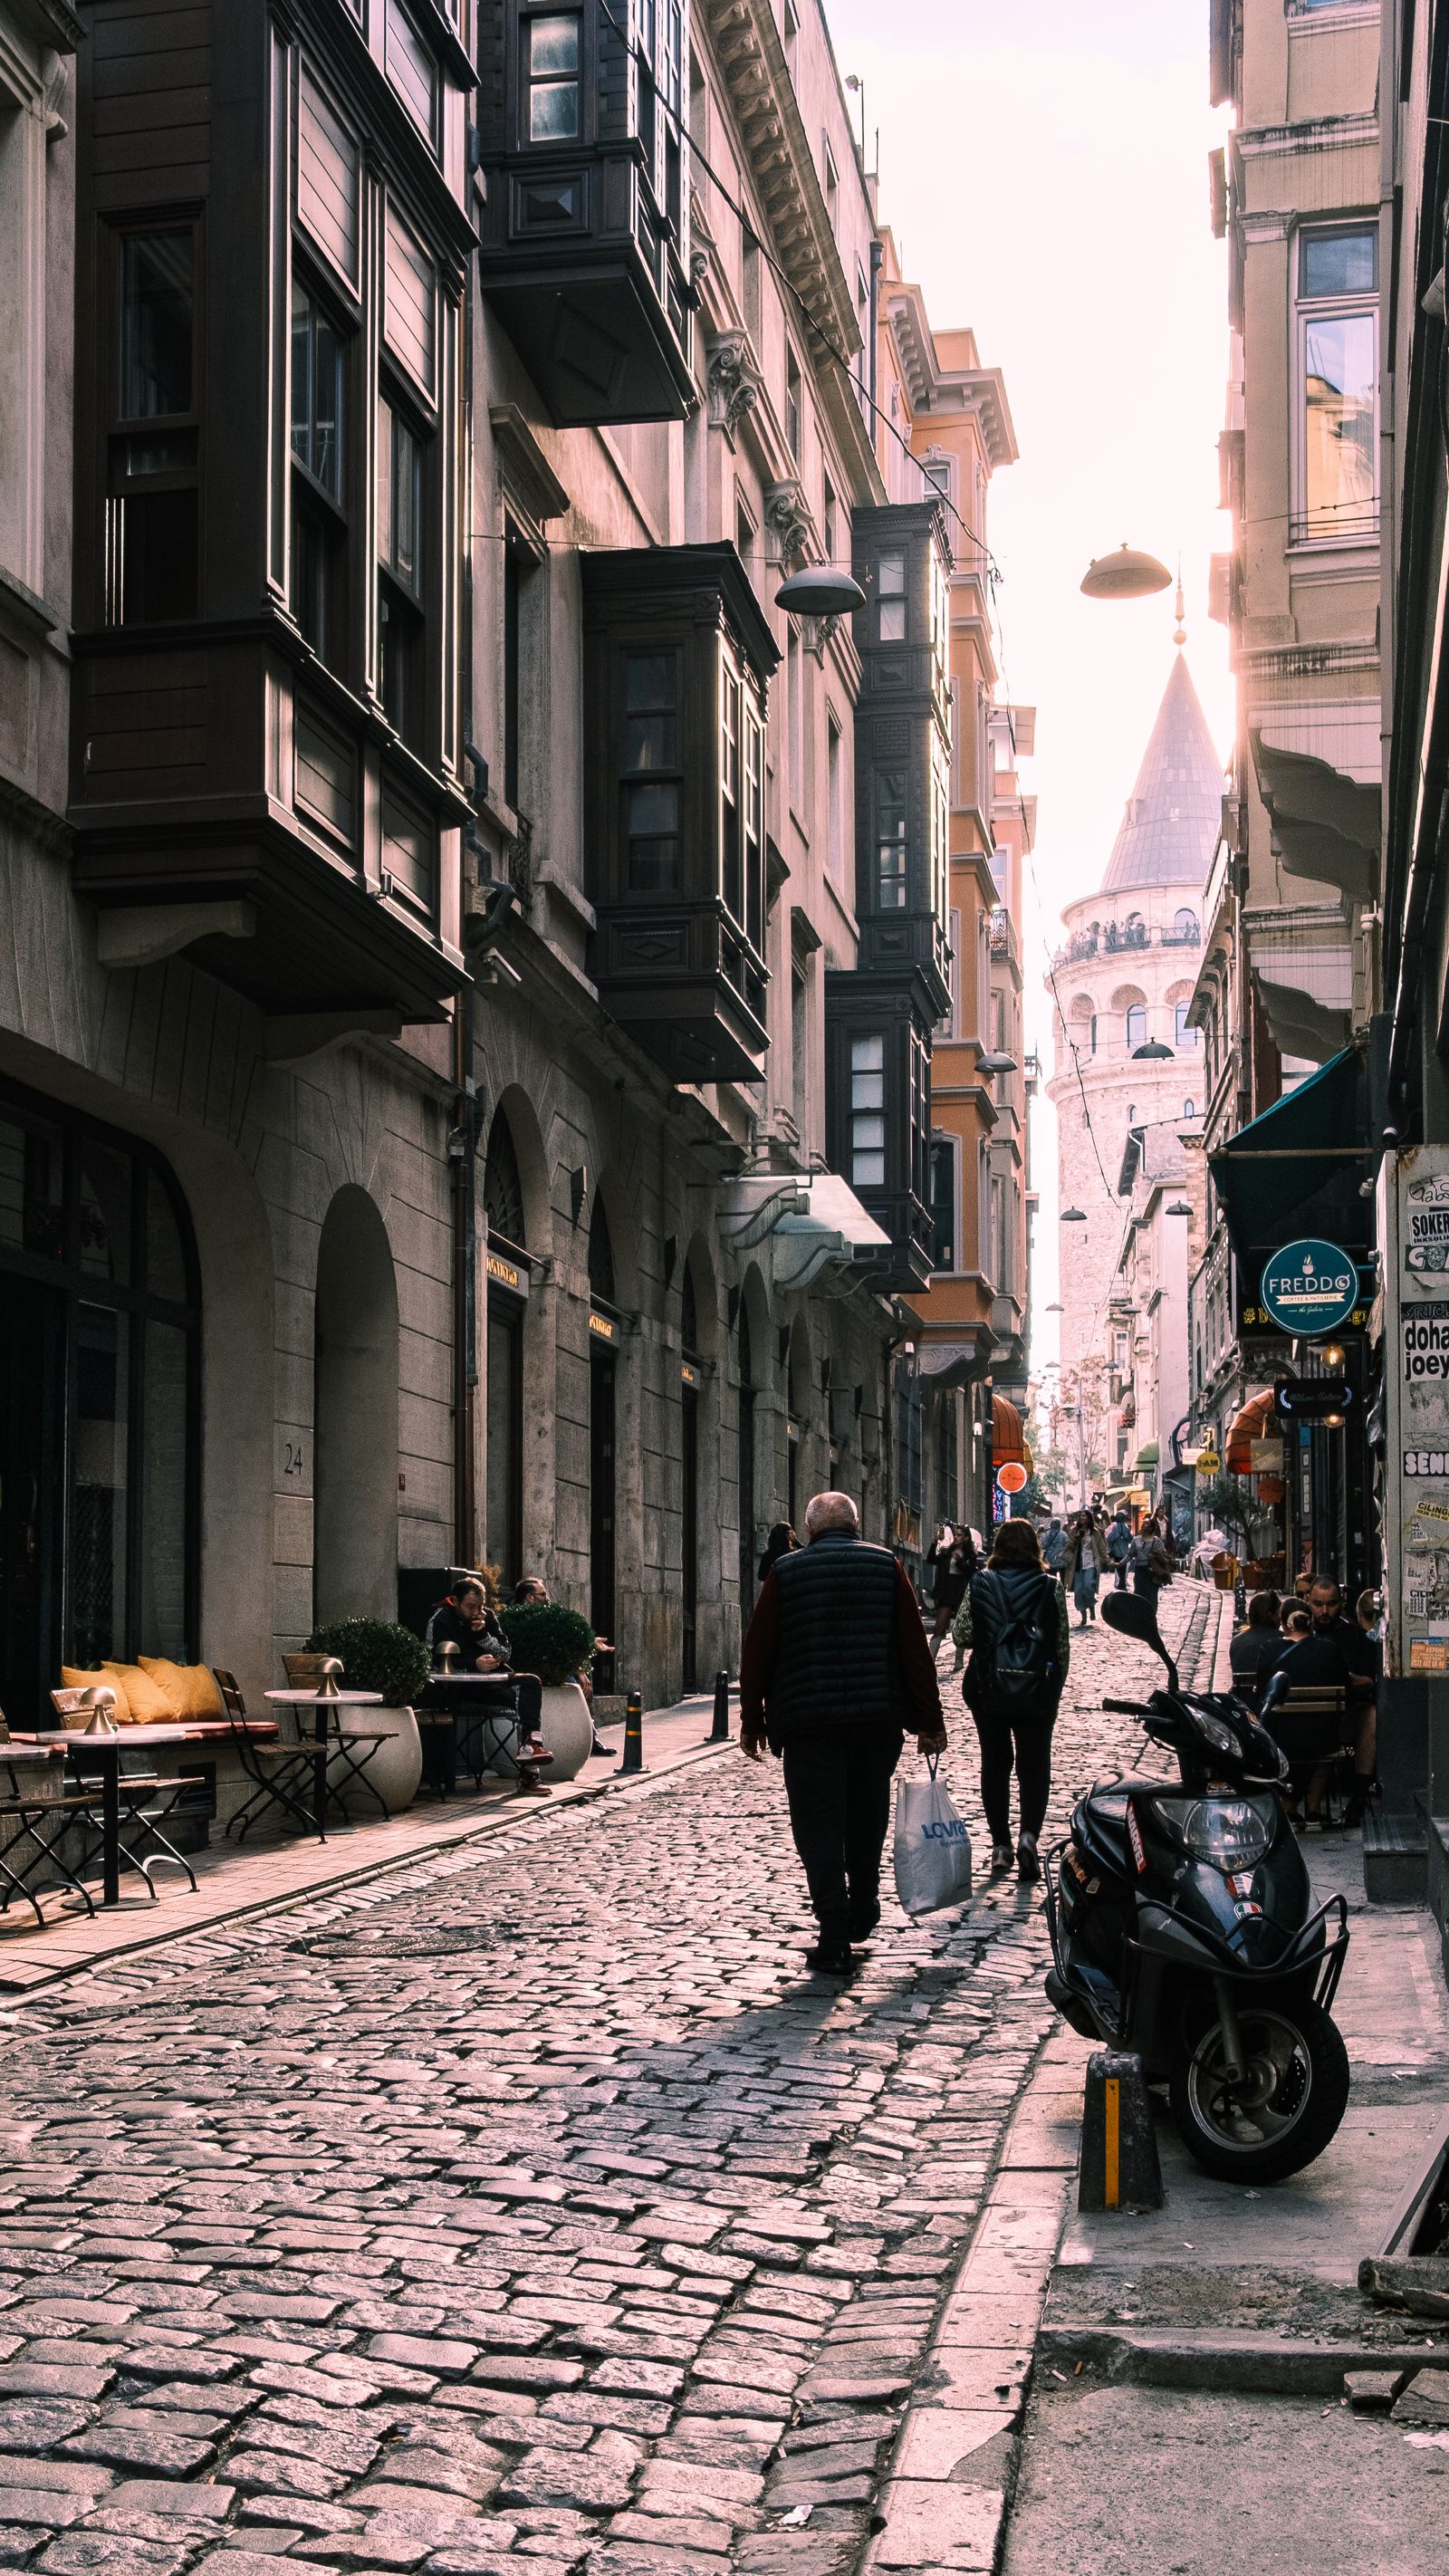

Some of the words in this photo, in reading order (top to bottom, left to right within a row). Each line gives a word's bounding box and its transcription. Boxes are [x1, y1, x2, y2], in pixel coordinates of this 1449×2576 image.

[1269, 1274, 1350, 1293] FREDDO
[284, 1443, 302, 1475] 24
[1127, 1805, 1144, 1870] MARVEL
